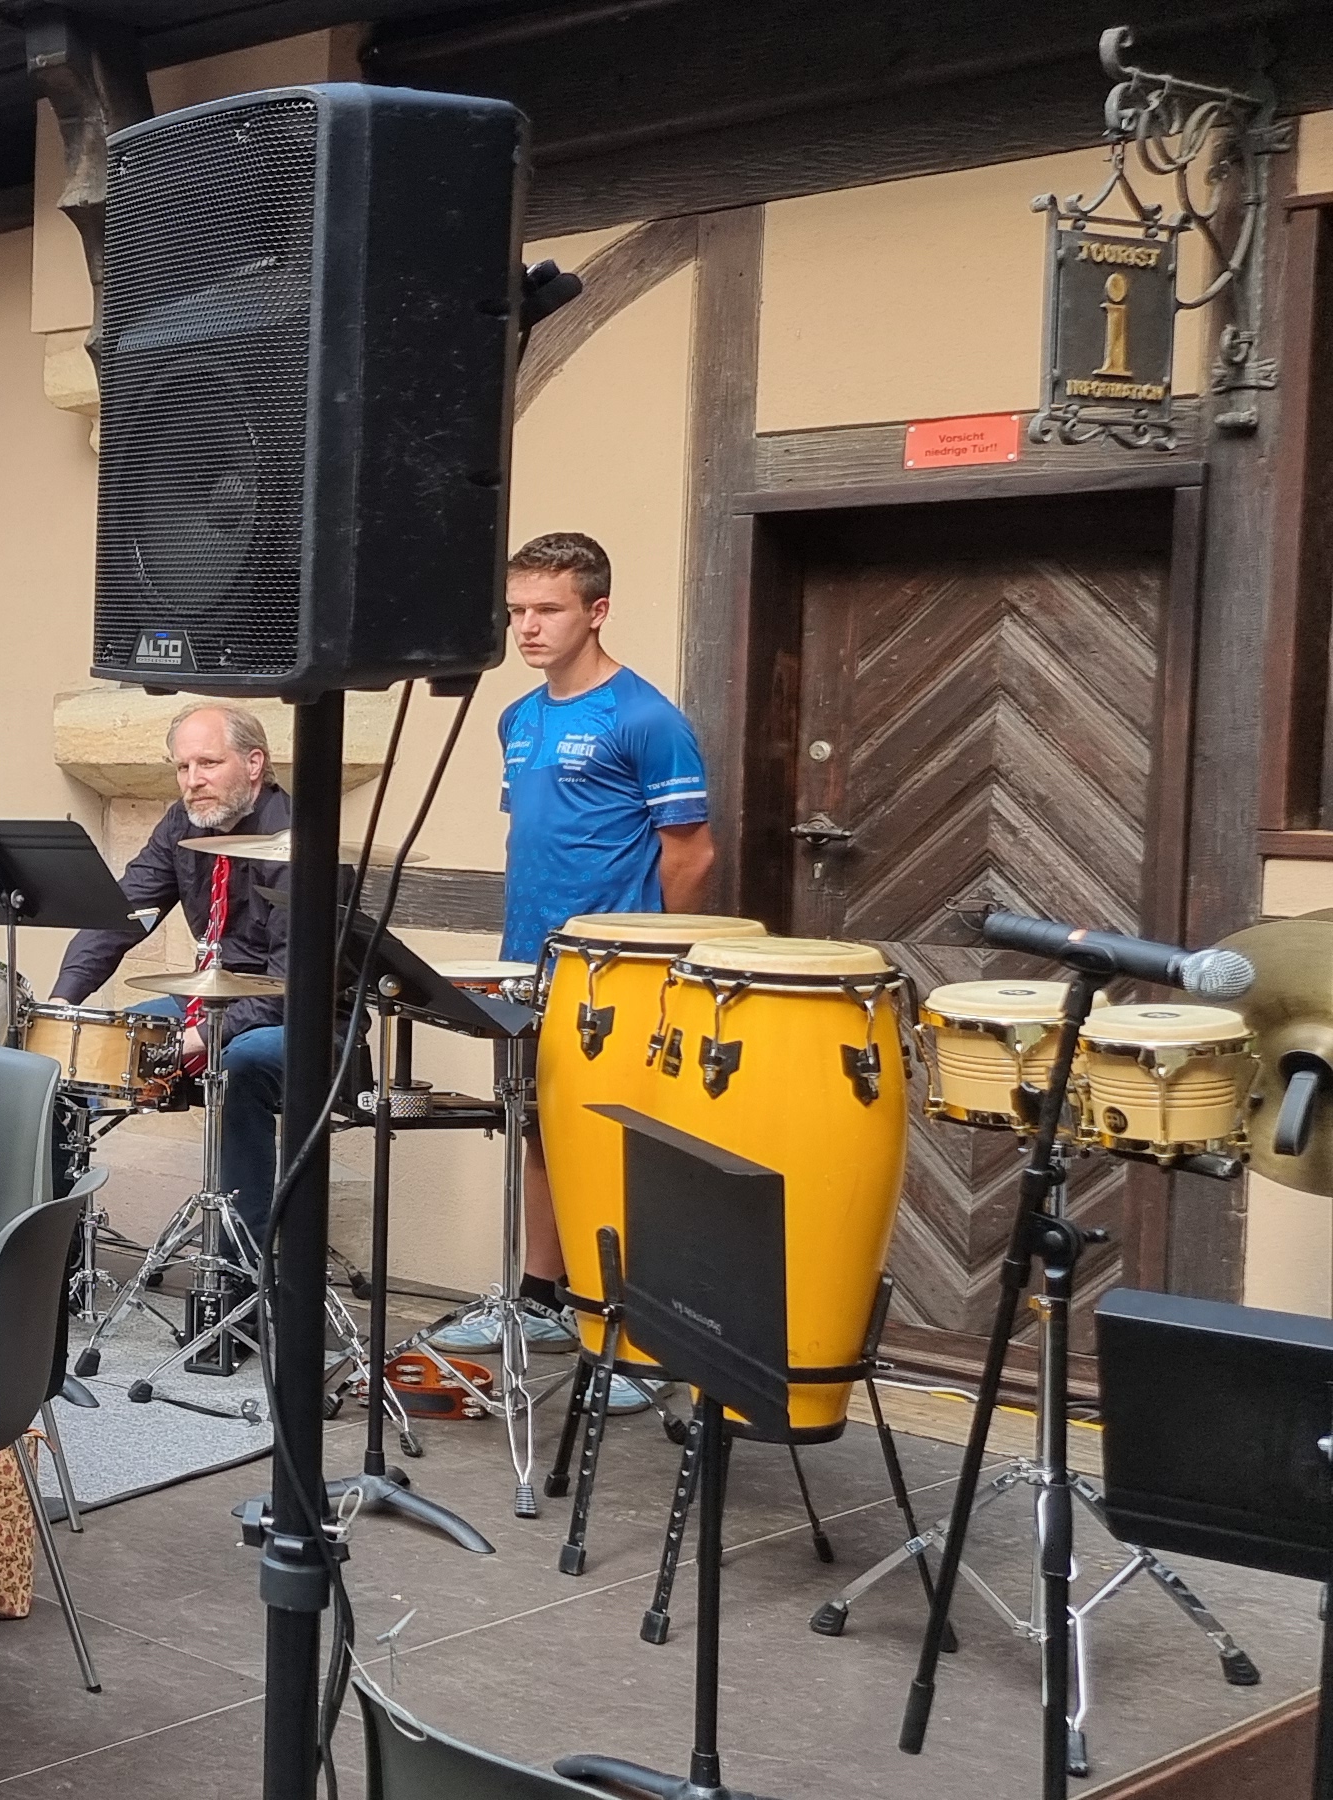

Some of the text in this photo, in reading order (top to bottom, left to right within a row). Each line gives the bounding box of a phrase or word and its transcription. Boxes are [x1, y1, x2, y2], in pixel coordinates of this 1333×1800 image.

[1074, 240, 1161, 268] TOURIST
[1065, 378, 1166, 401] INFORMATION
[938, 432, 985, 444] Vorsicht
[924, 446, 969, 457] niedrige
[136, 634, 182, 657] ALTO
